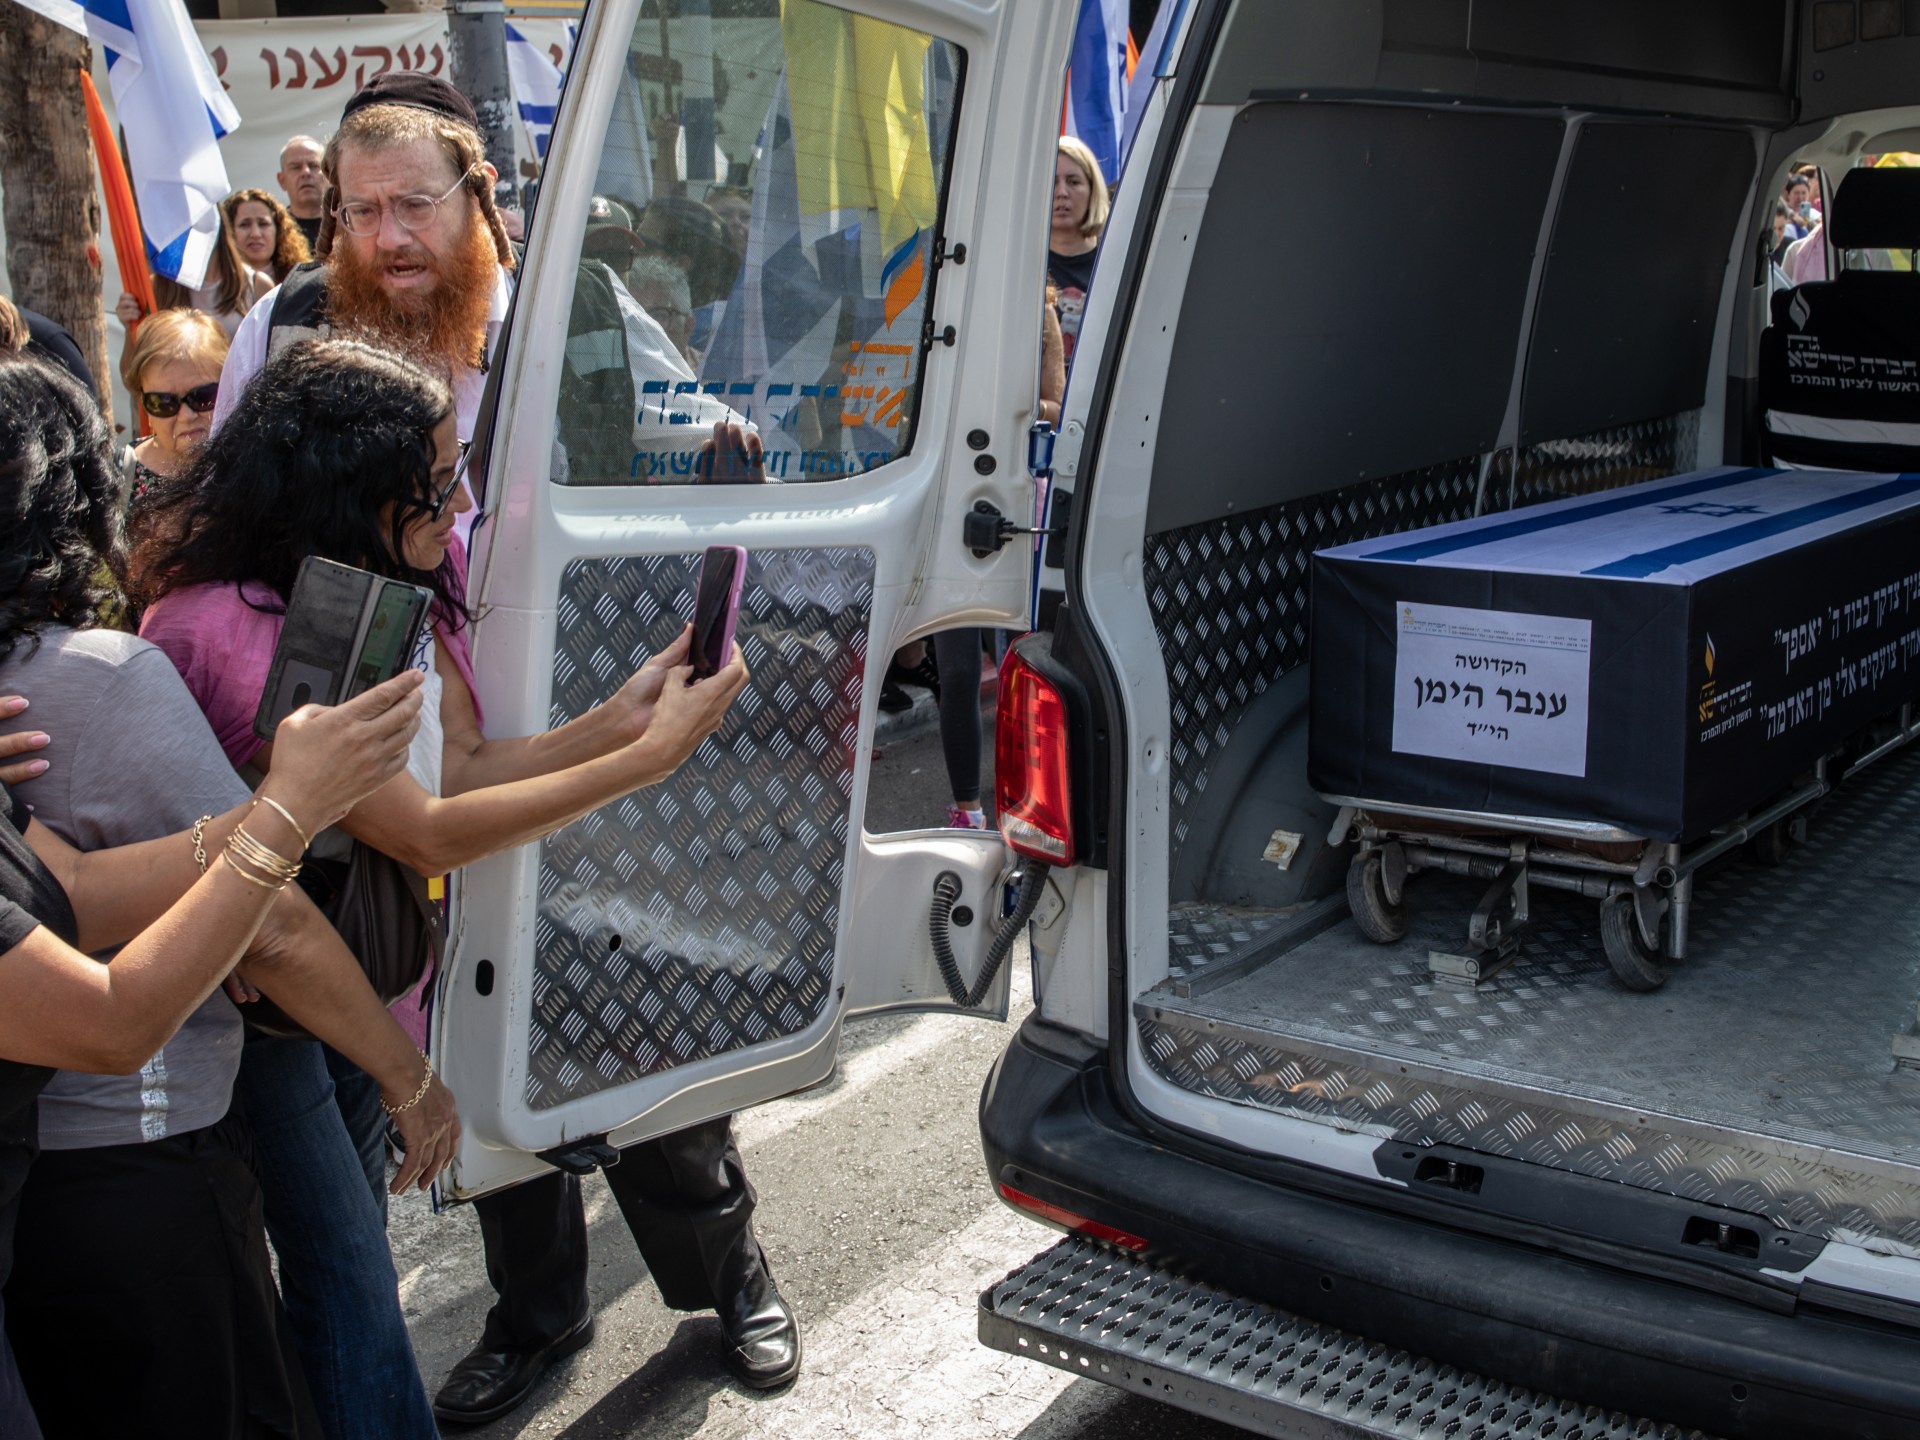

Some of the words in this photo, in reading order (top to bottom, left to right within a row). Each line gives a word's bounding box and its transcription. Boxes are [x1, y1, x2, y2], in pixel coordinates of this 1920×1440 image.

[260, 42, 453, 91] שקענו
[1787, 350, 1856, 374] קדישא
[1860, 356, 1917, 377] חברה
[1790, 374, 1836, 387] והמרכז
[1839, 378, 1874, 389] לציון
[1844, 595, 1870, 634] כבוד
[1873, 580, 1900, 629] צדקך
[1455, 653, 1527, 677] הקדושה
[1836, 656, 1857, 698] אלי
[1860, 640, 1897, 691] צועקים
[1413, 675, 1484, 709] הימן
[1496, 686, 1567, 720] ענבר
[1818, 676, 1831, 722] מן
